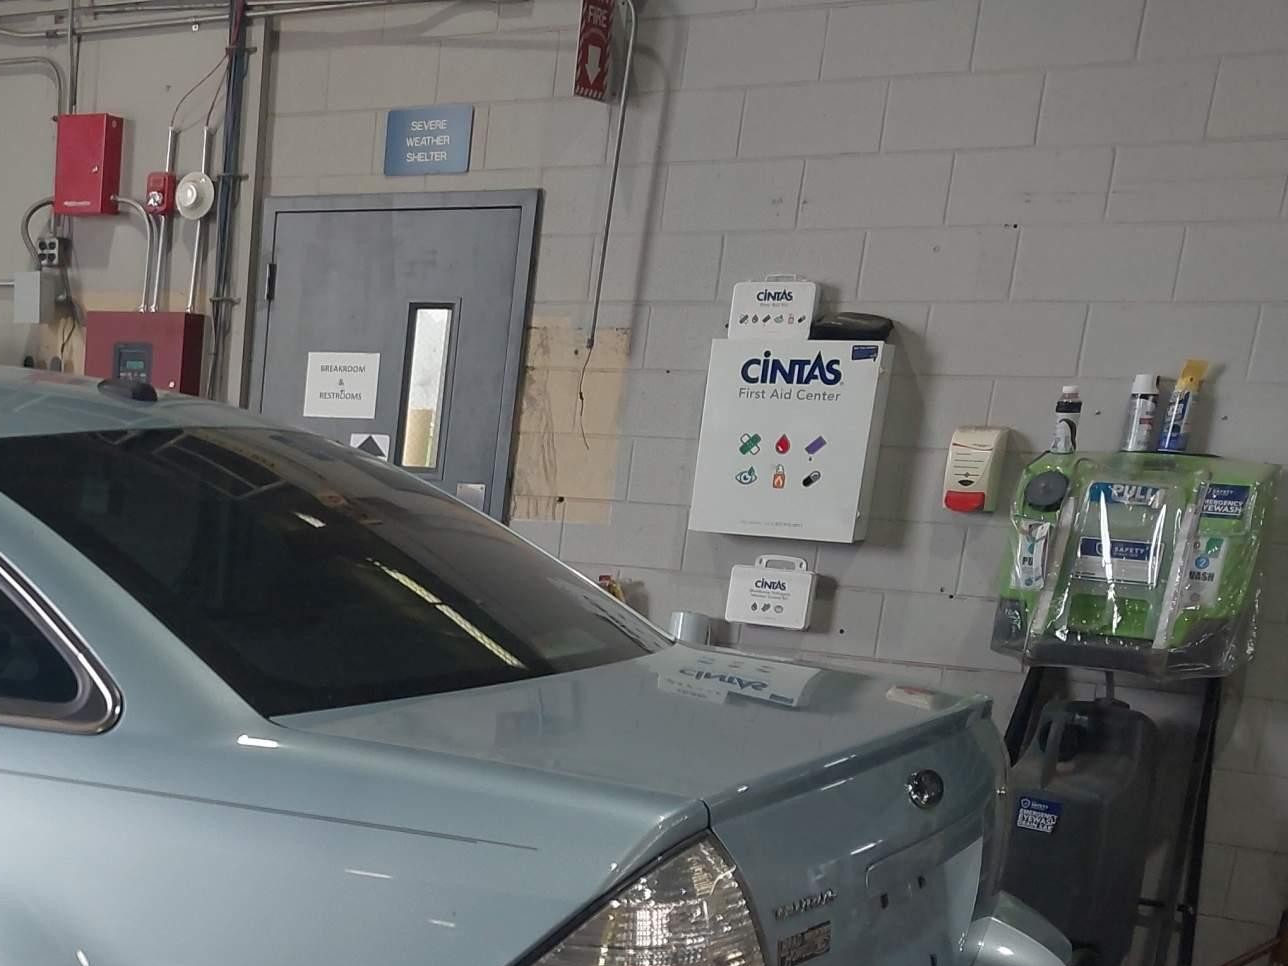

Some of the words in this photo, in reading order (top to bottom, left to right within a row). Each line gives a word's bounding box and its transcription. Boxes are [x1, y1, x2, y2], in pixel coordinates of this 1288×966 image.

[411, 120, 447, 131] SEVERE
[406, 136, 450, 147] WEATHER
[405, 152, 447, 162] SHELTER
[320, 365, 366, 373] BREAKROOM
[319, 392, 362, 400] RESTROOMS
[738, 388, 765, 399] First
[770, 389, 792, 400] Aid
[796, 389, 841, 401] Center
[1204, 505, 1242, 513] YEWASH
